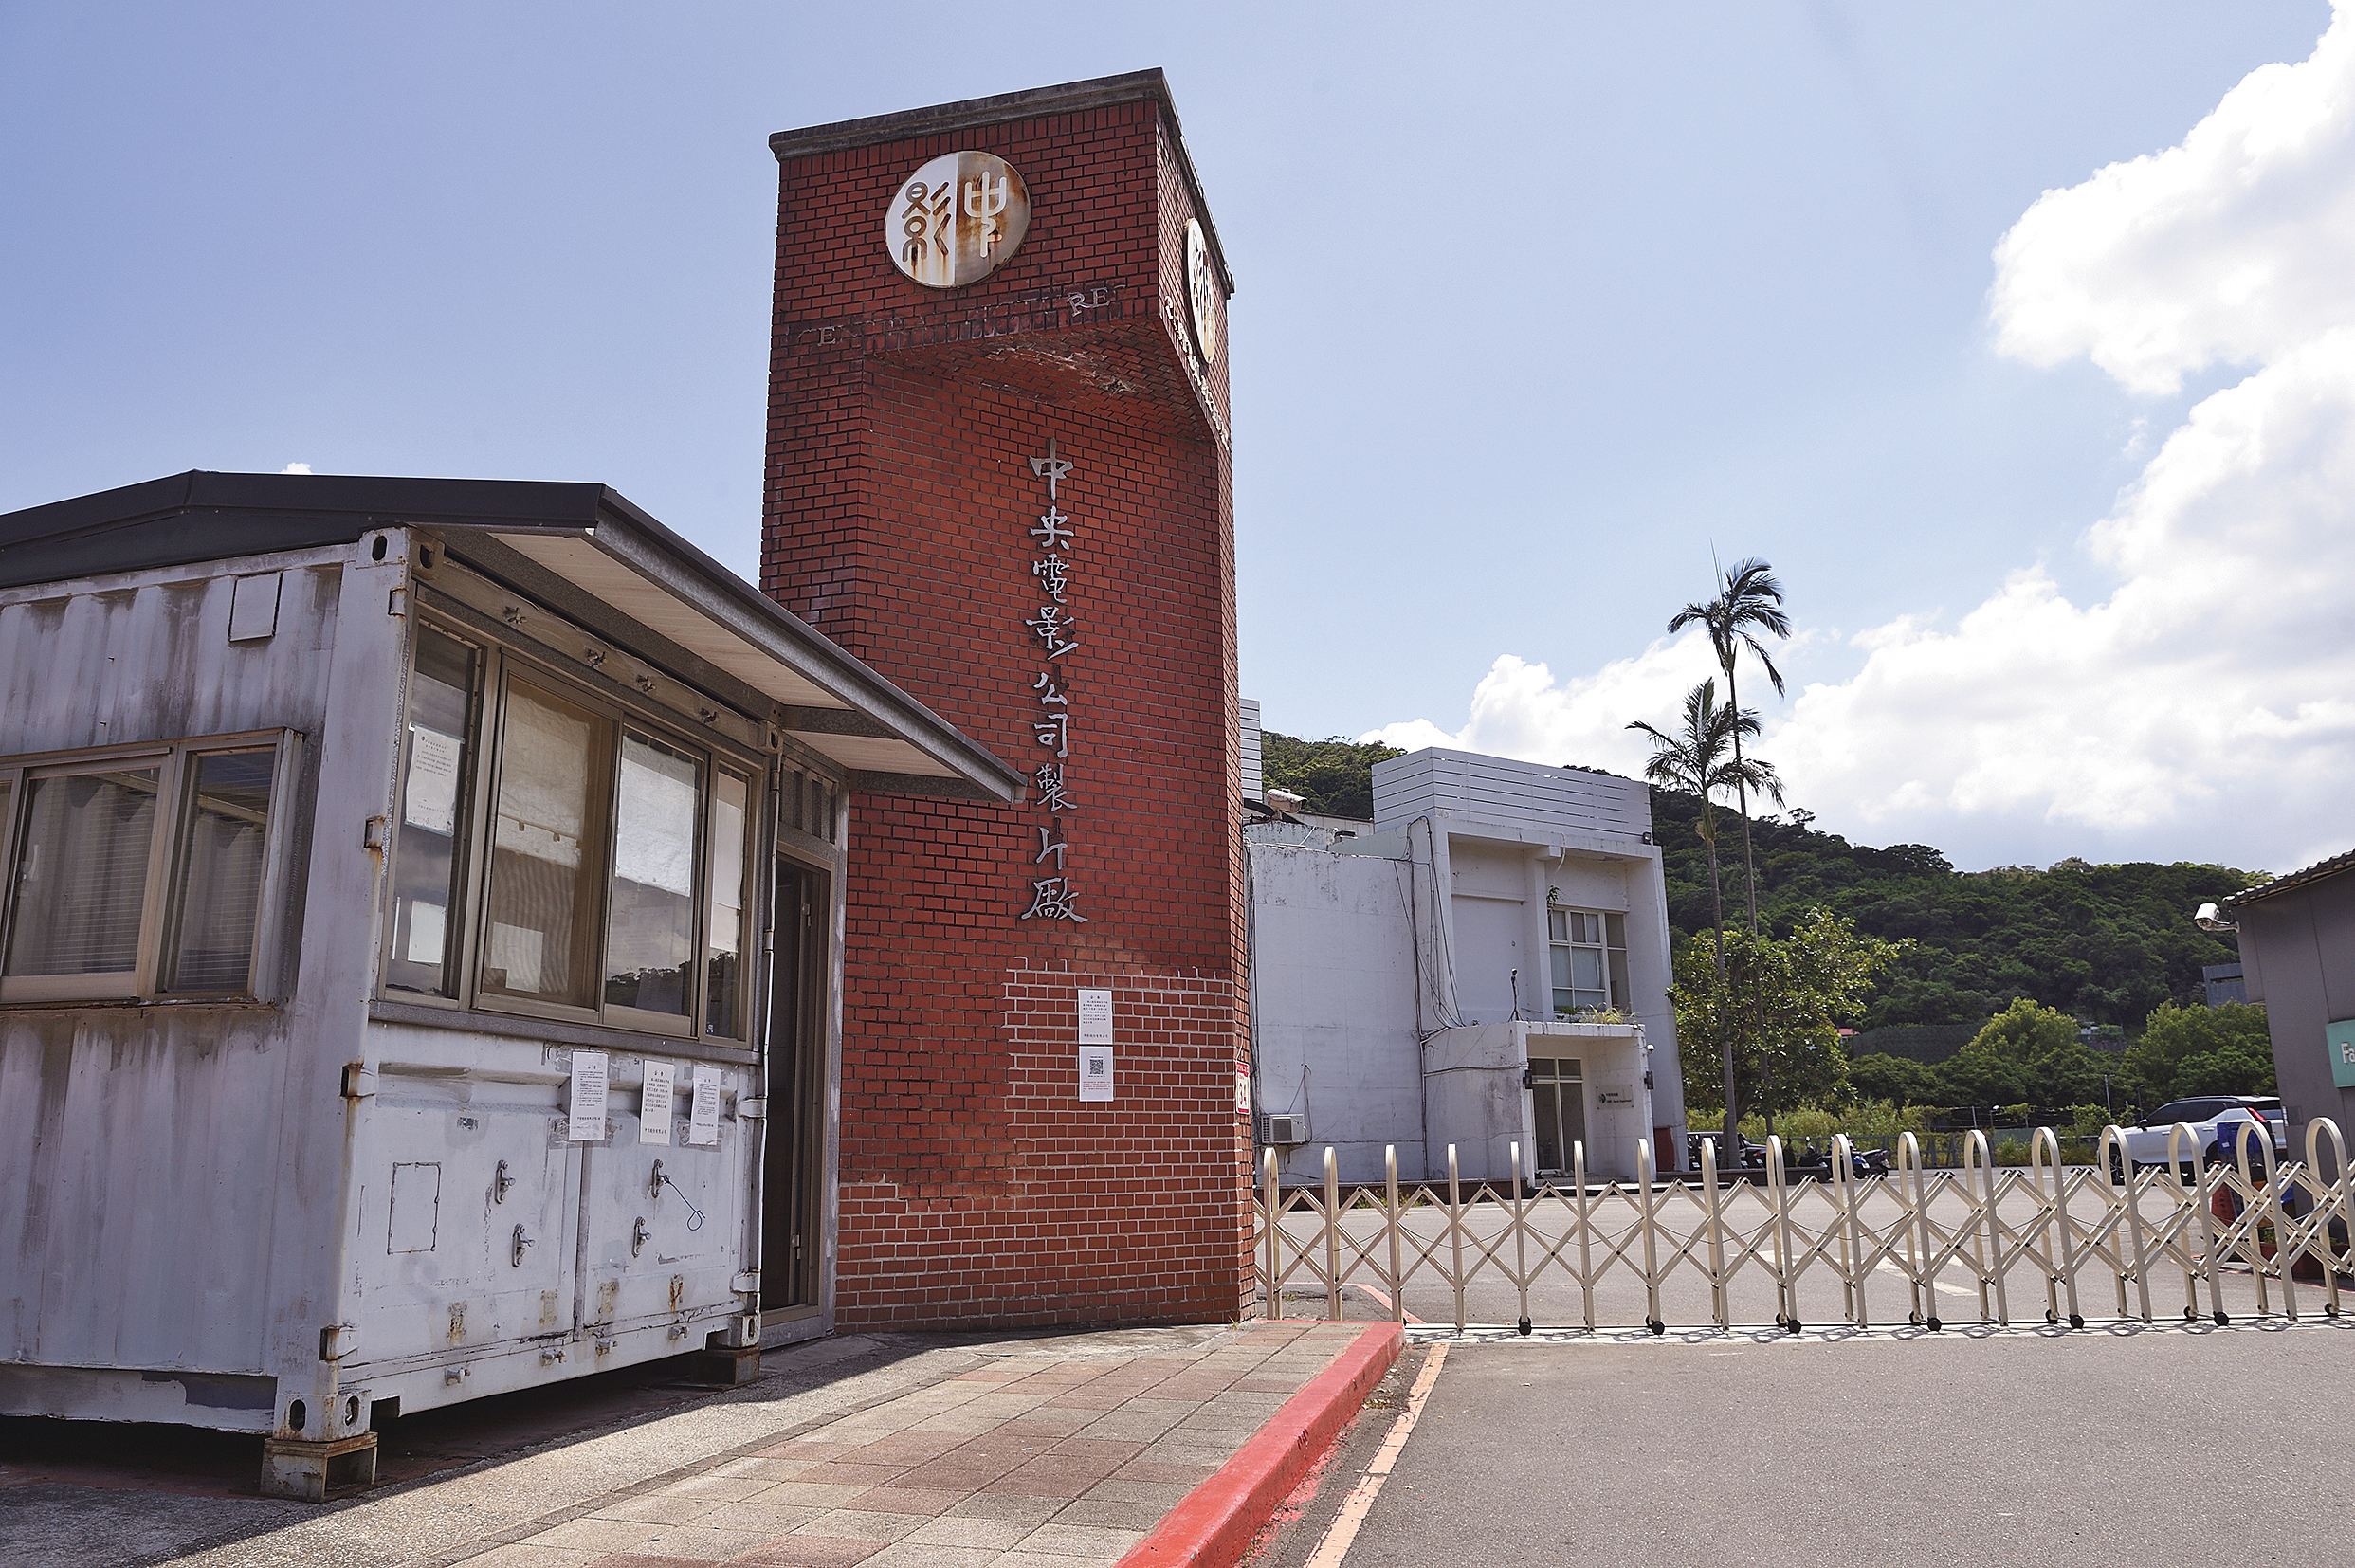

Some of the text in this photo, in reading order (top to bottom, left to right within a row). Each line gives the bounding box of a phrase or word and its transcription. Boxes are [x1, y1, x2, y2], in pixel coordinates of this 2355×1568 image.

[1019, 437, 1088, 922] 中央電影公司製片廠
